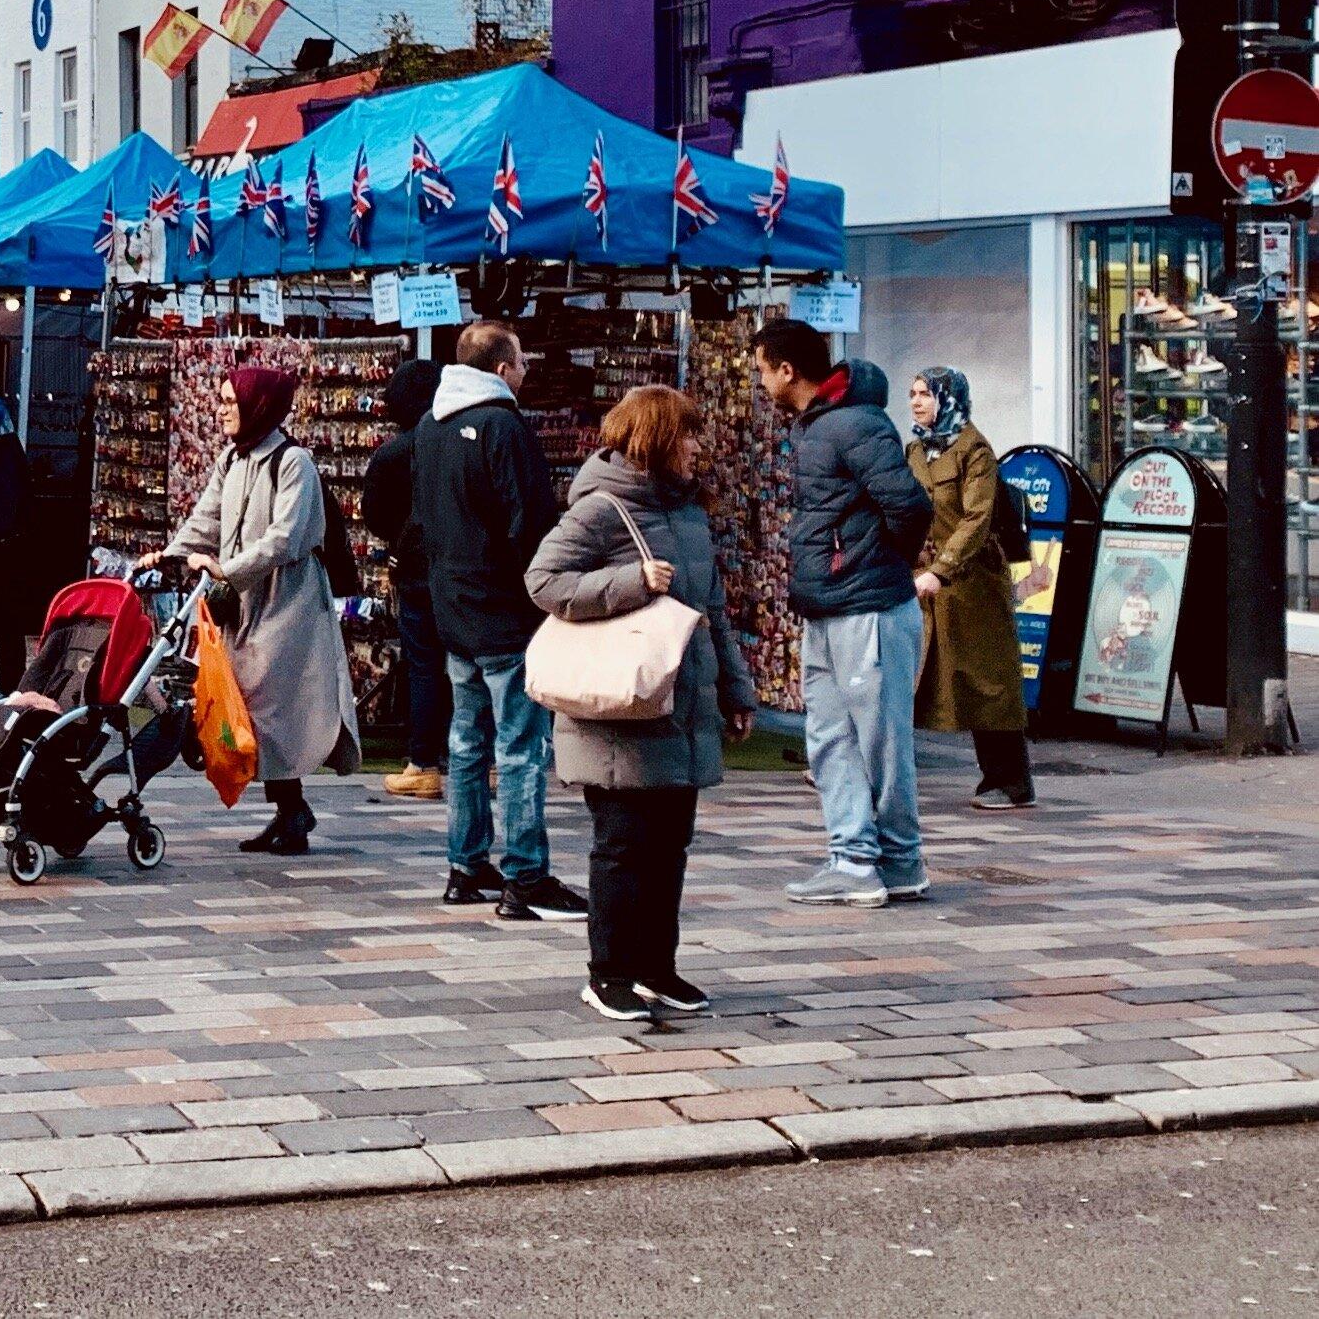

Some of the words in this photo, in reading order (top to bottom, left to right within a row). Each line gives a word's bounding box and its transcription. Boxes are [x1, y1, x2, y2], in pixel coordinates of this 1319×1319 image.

[1144, 460, 1169, 473] OUT
[1152, 475, 1173, 488] THE
[1144, 489, 1179, 503] FLOOR
[1132, 501, 1188, 517] RECORDS
